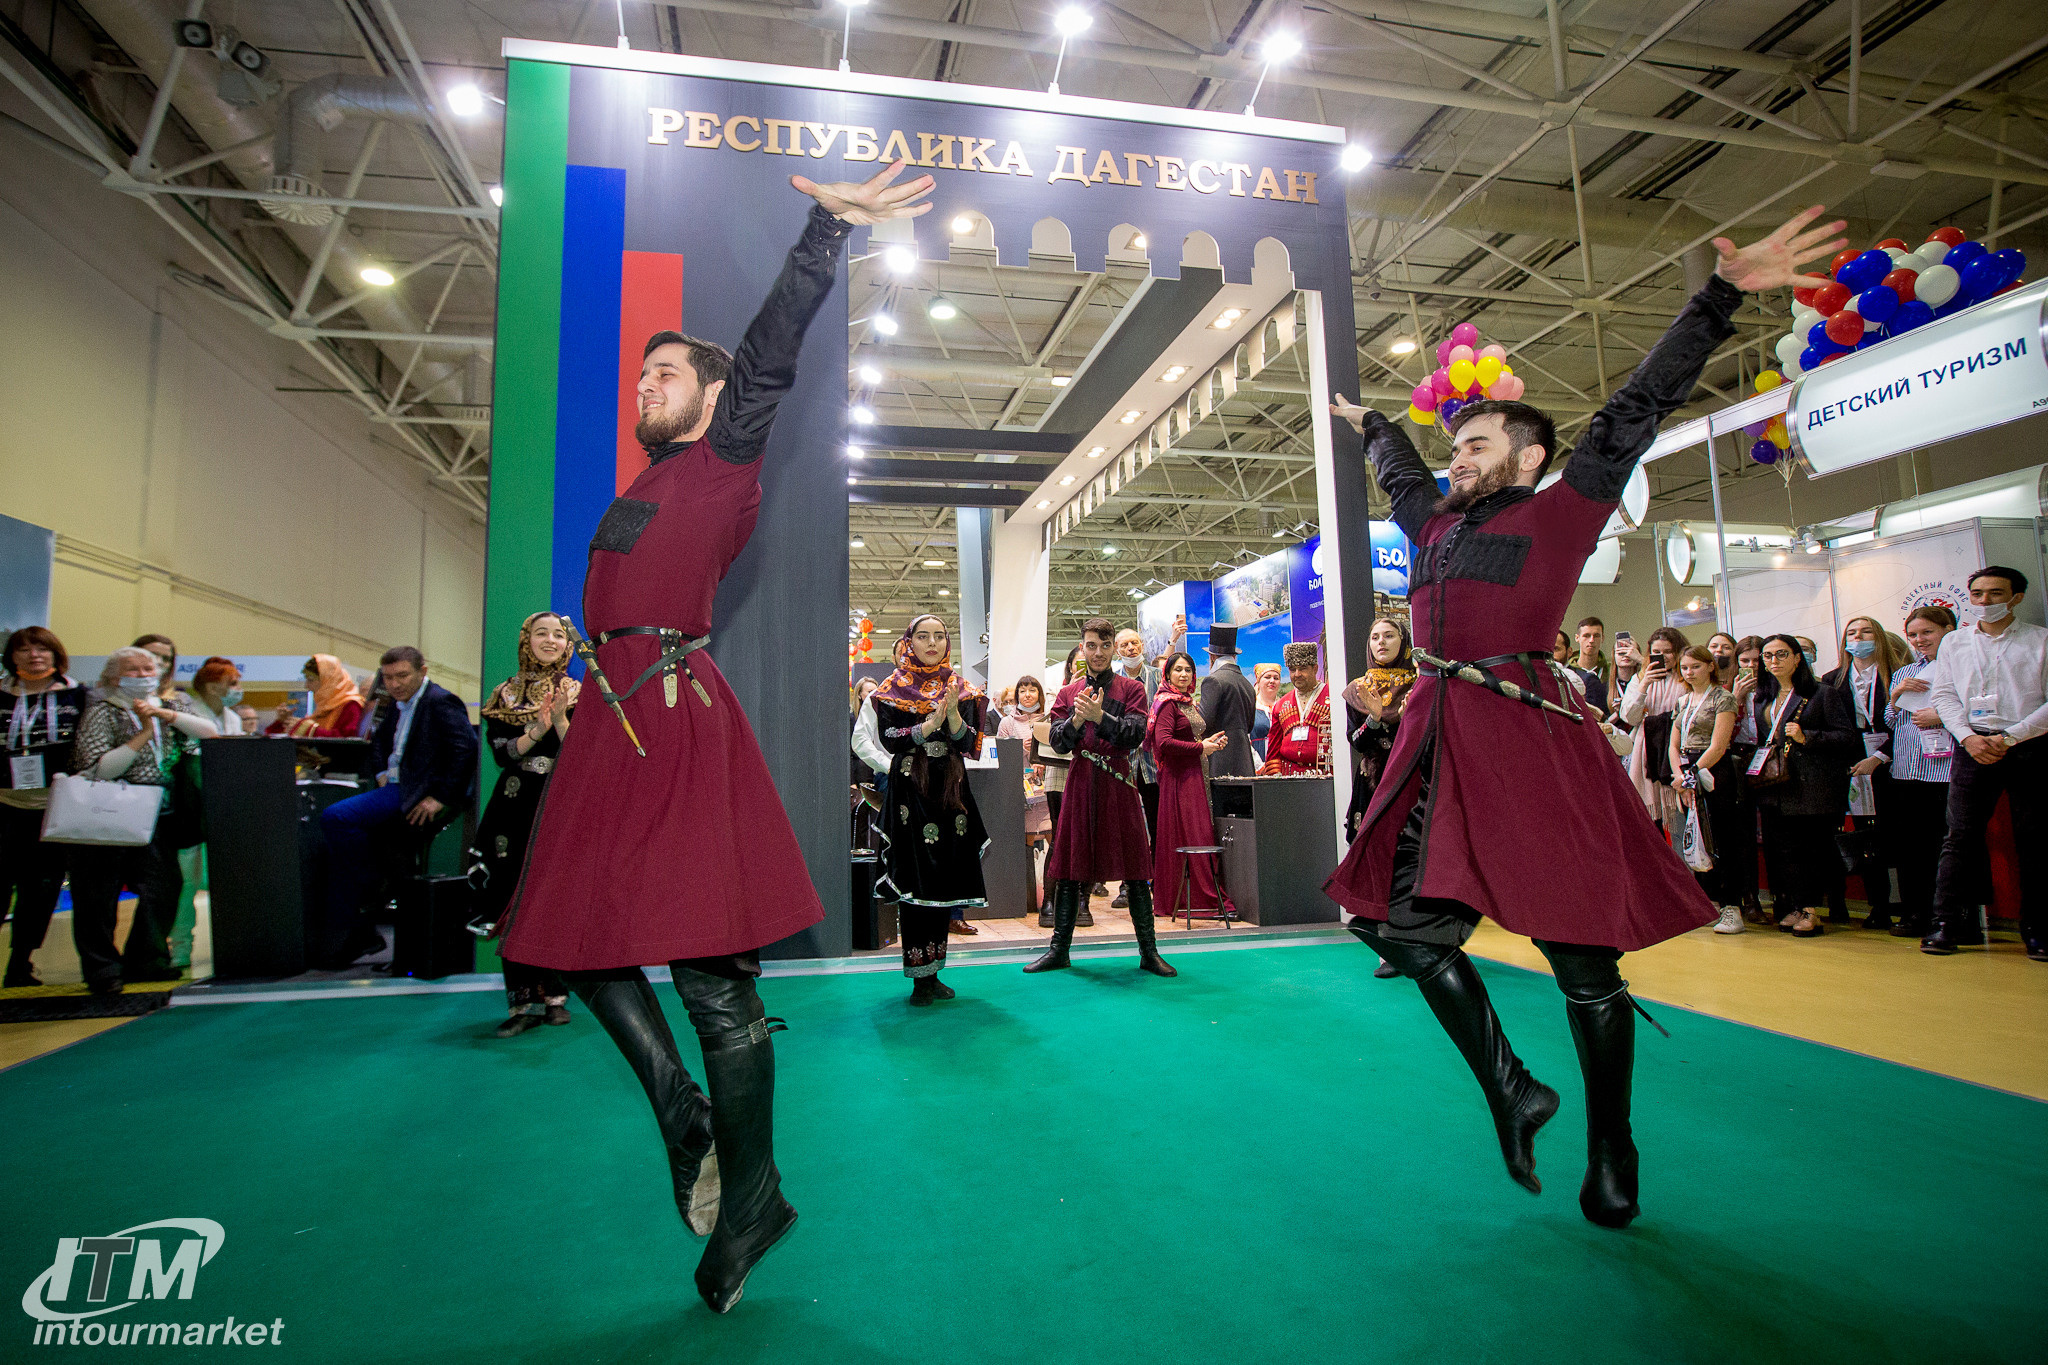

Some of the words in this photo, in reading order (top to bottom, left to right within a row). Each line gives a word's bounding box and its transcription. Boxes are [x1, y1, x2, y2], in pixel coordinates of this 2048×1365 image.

[648, 107, 1033, 176] РЕСПУБЛИКА
[1048, 145, 1319, 204] ДАГЕСТАН
[1808, 377, 1911, 430] ДЕТСКИЙ
[1918, 337, 2028, 388] ТУРИЗМ
[1900, 581, 1942, 610] ПРОЕКТНЫЙ
[1948, 584, 1969, 603] ОФИС
